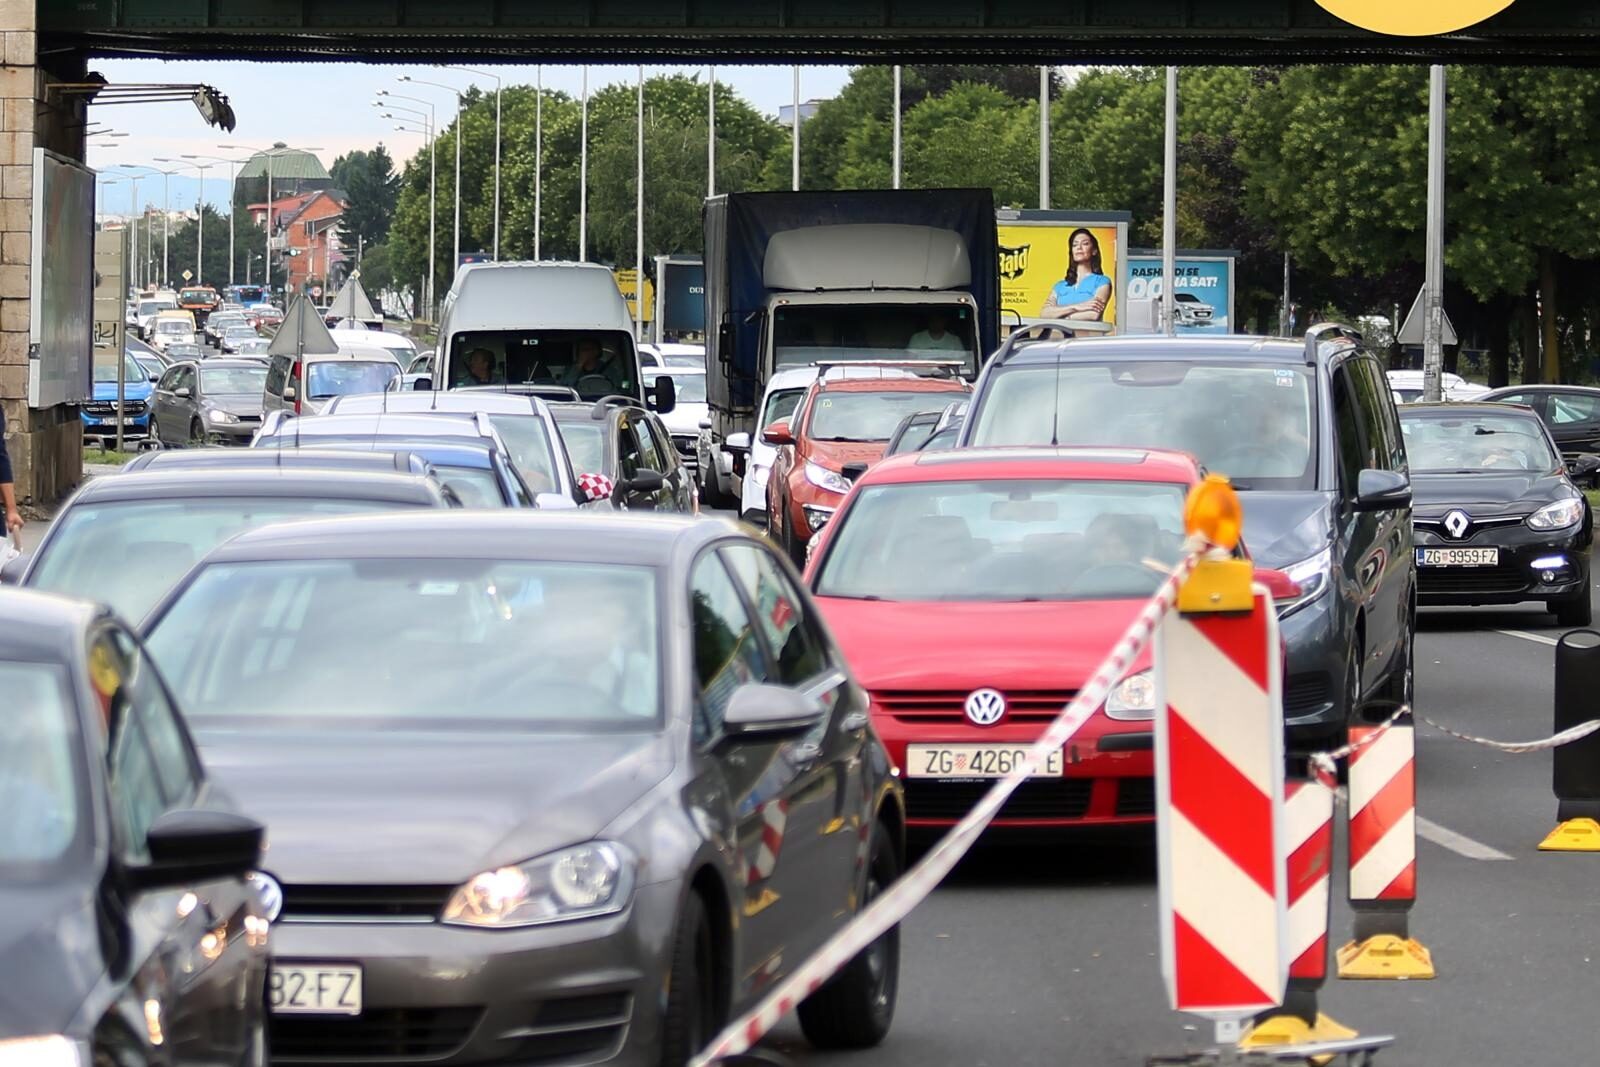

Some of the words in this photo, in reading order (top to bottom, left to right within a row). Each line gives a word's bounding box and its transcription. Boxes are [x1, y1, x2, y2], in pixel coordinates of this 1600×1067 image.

[1131, 268, 1184, 277] RASHDI
[1187, 268, 1199, 277] SE
[1190, 277, 1218, 287] SAT!
[1426, 550, 1441, 563] ZG
[1449, 550, 1496, 563] 9959-FZ
[925, 750, 953, 774] ZG
